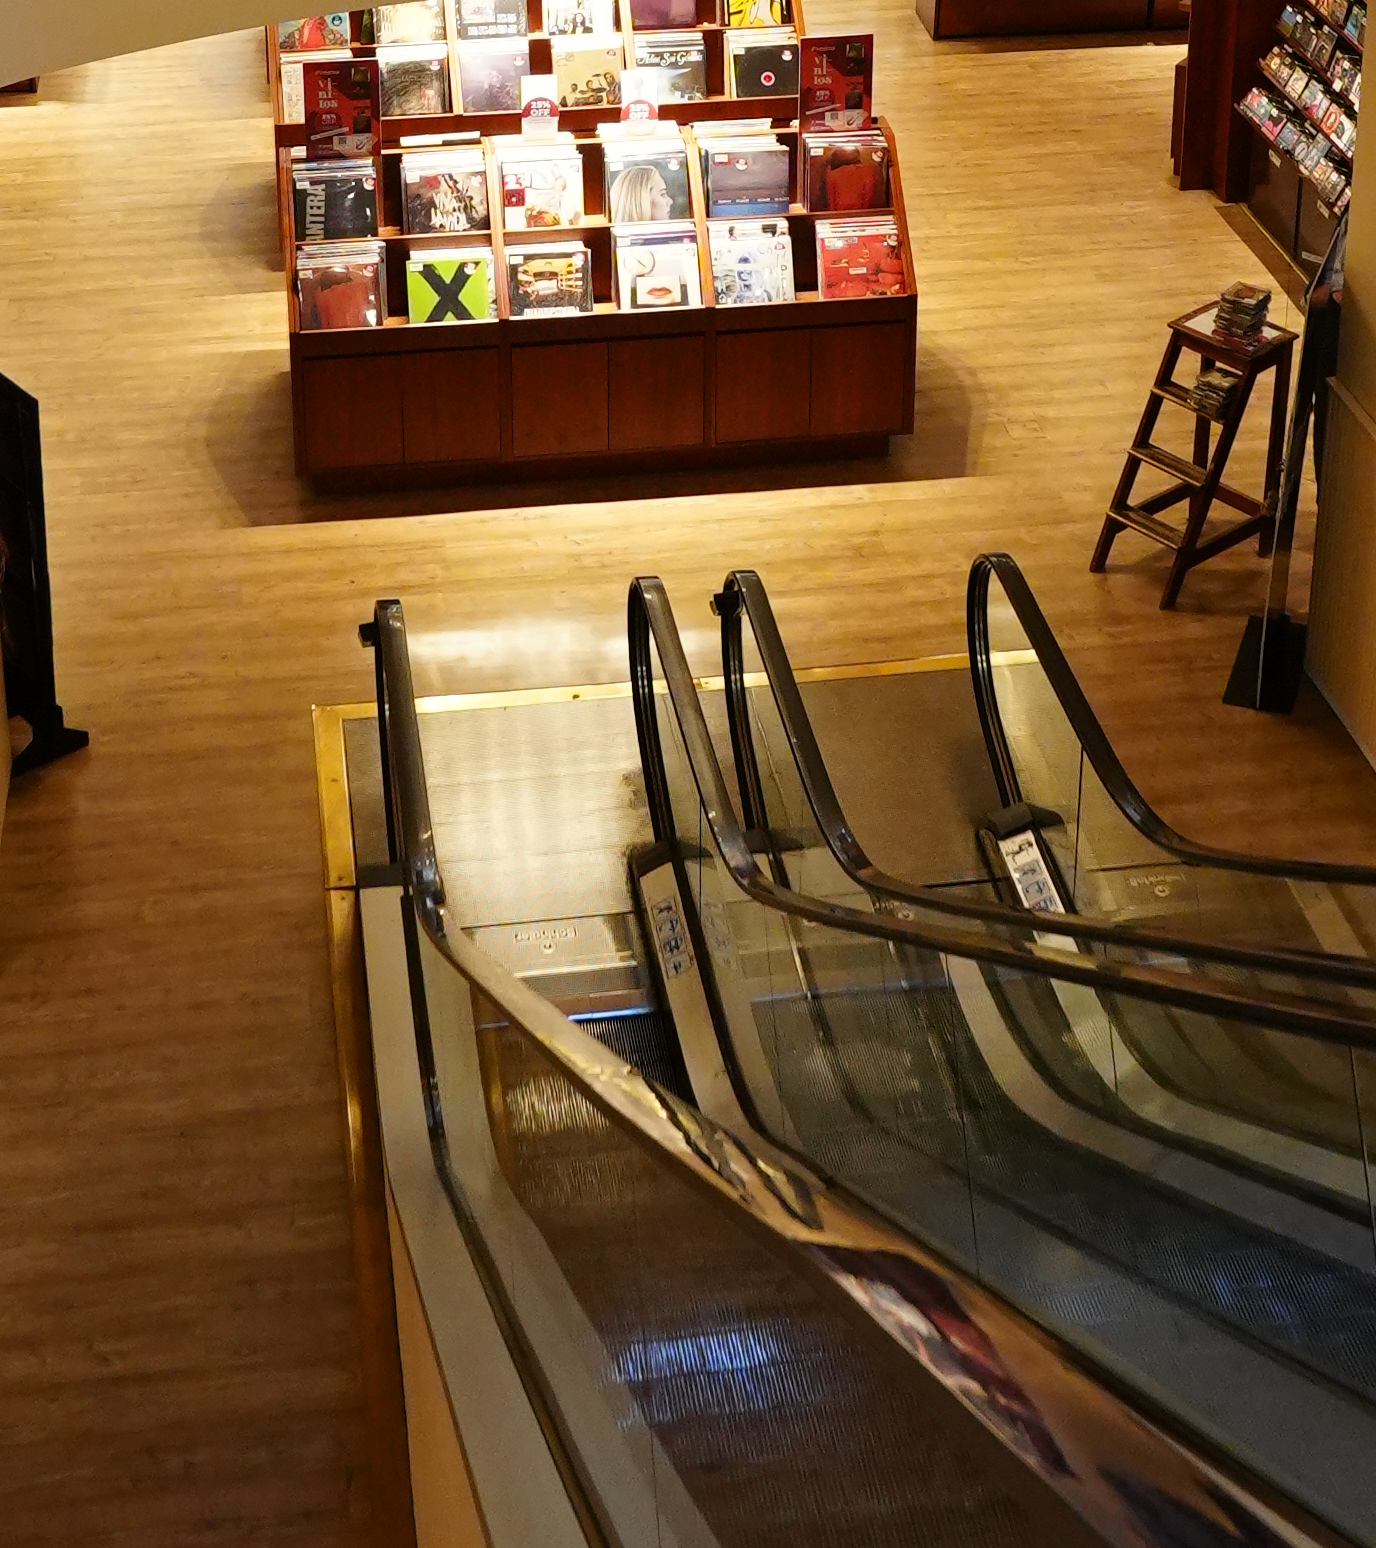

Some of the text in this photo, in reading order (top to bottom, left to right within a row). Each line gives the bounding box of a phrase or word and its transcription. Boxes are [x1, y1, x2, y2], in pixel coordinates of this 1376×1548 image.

[529, 108, 550, 117] OFF
[628, 111, 647, 120] OFF
[504, 174, 525, 189] 23
